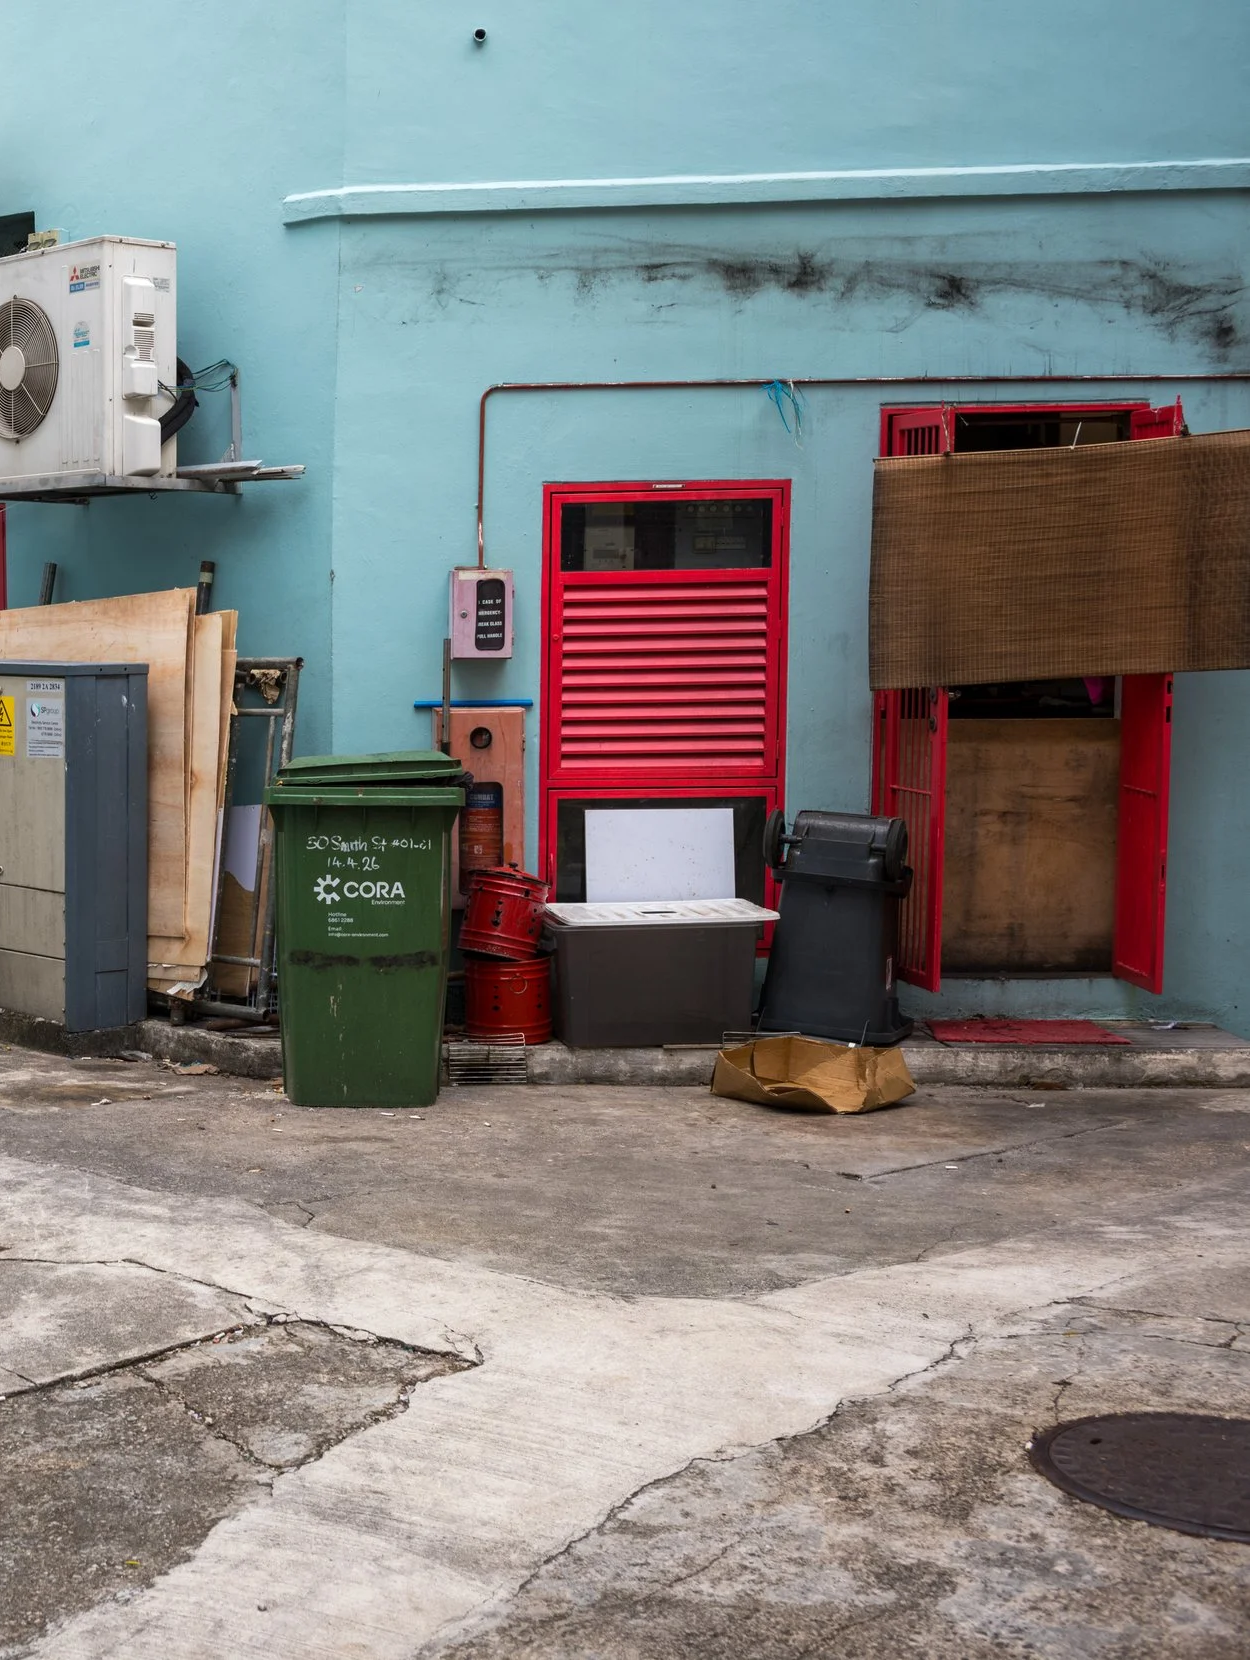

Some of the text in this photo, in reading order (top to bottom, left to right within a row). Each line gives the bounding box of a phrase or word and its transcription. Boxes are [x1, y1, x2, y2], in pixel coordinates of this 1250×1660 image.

[80, 265, 100, 274] MITSUBISHI
[80, 271, 97, 279] ELECTRIC
[343, 881, 406, 898] CORA
